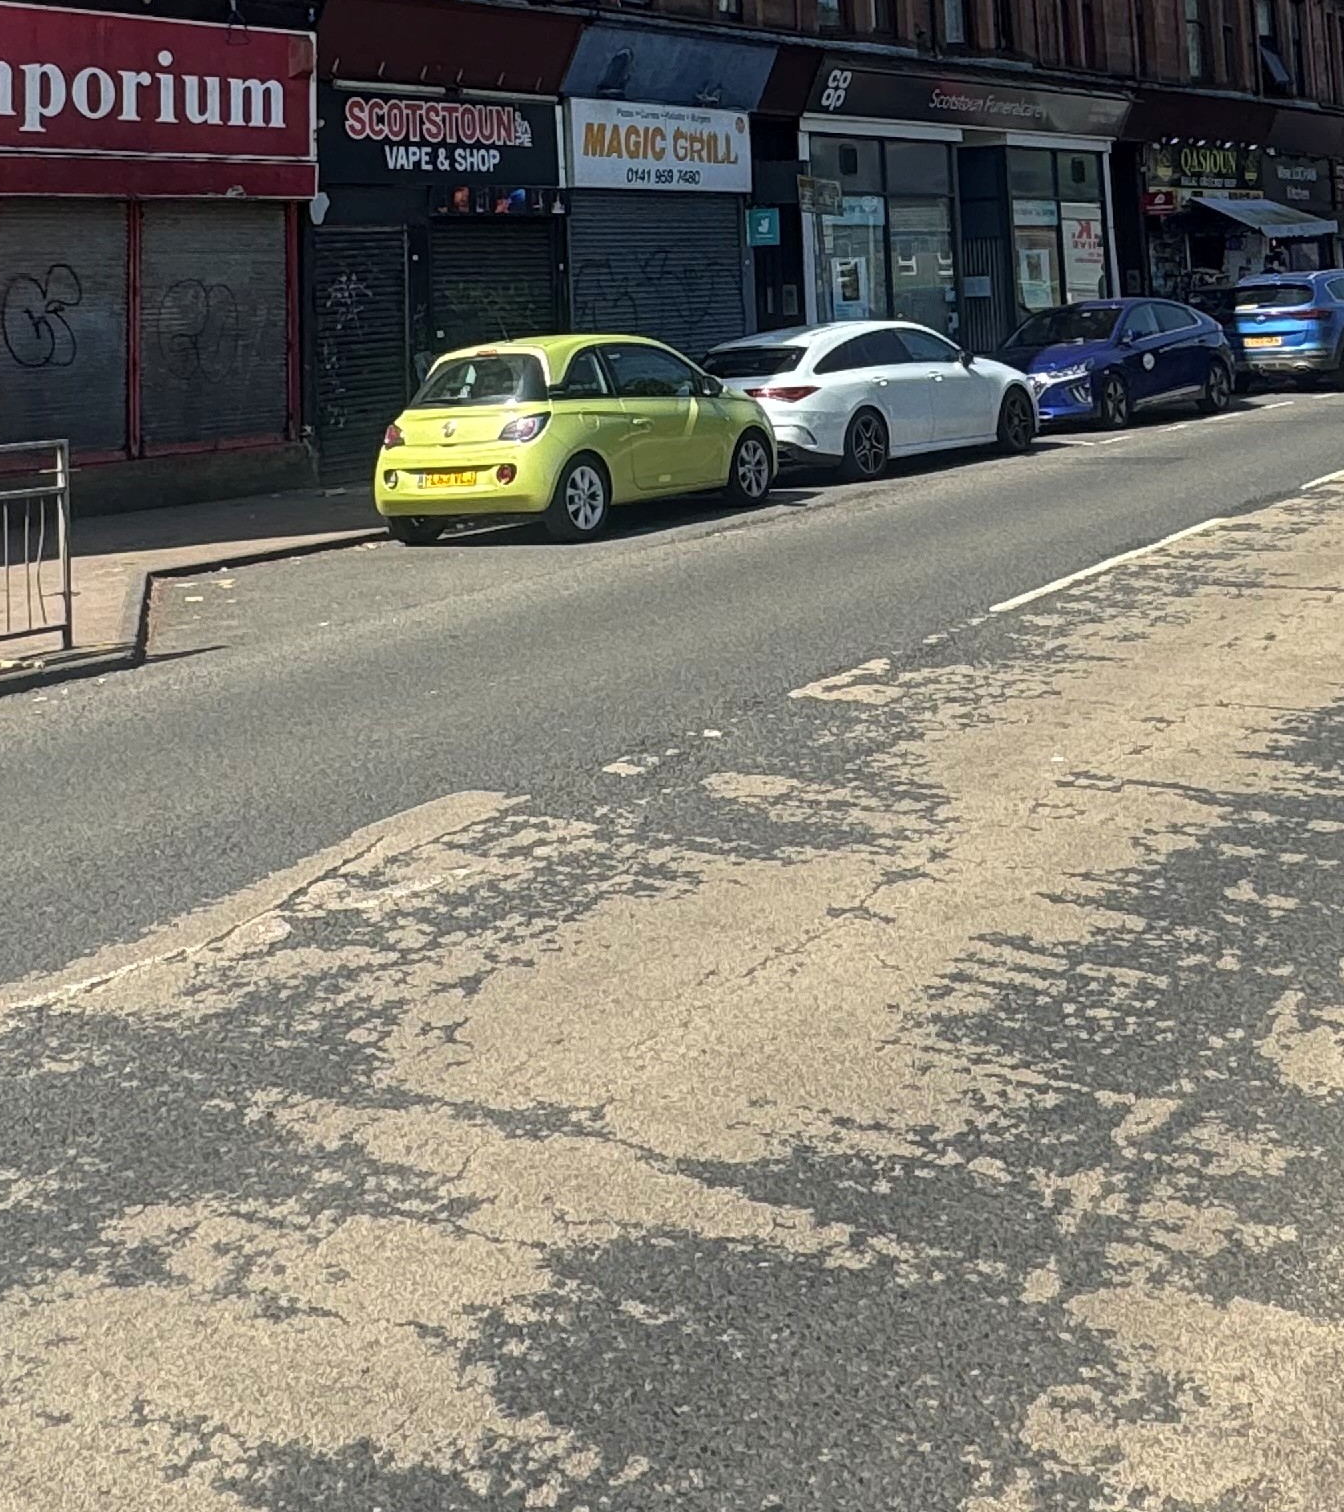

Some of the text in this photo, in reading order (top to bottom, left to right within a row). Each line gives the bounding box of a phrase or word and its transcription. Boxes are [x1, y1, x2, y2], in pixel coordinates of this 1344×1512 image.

[345, 97, 516, 146] SCOTSTOUN
[583, 123, 739, 165] MAGIC GRILL
[385, 145, 500, 172] VAPE & SHOP
[1181, 148, 1237, 176] QASIOUN
[626, 167, 651, 183] 0141
